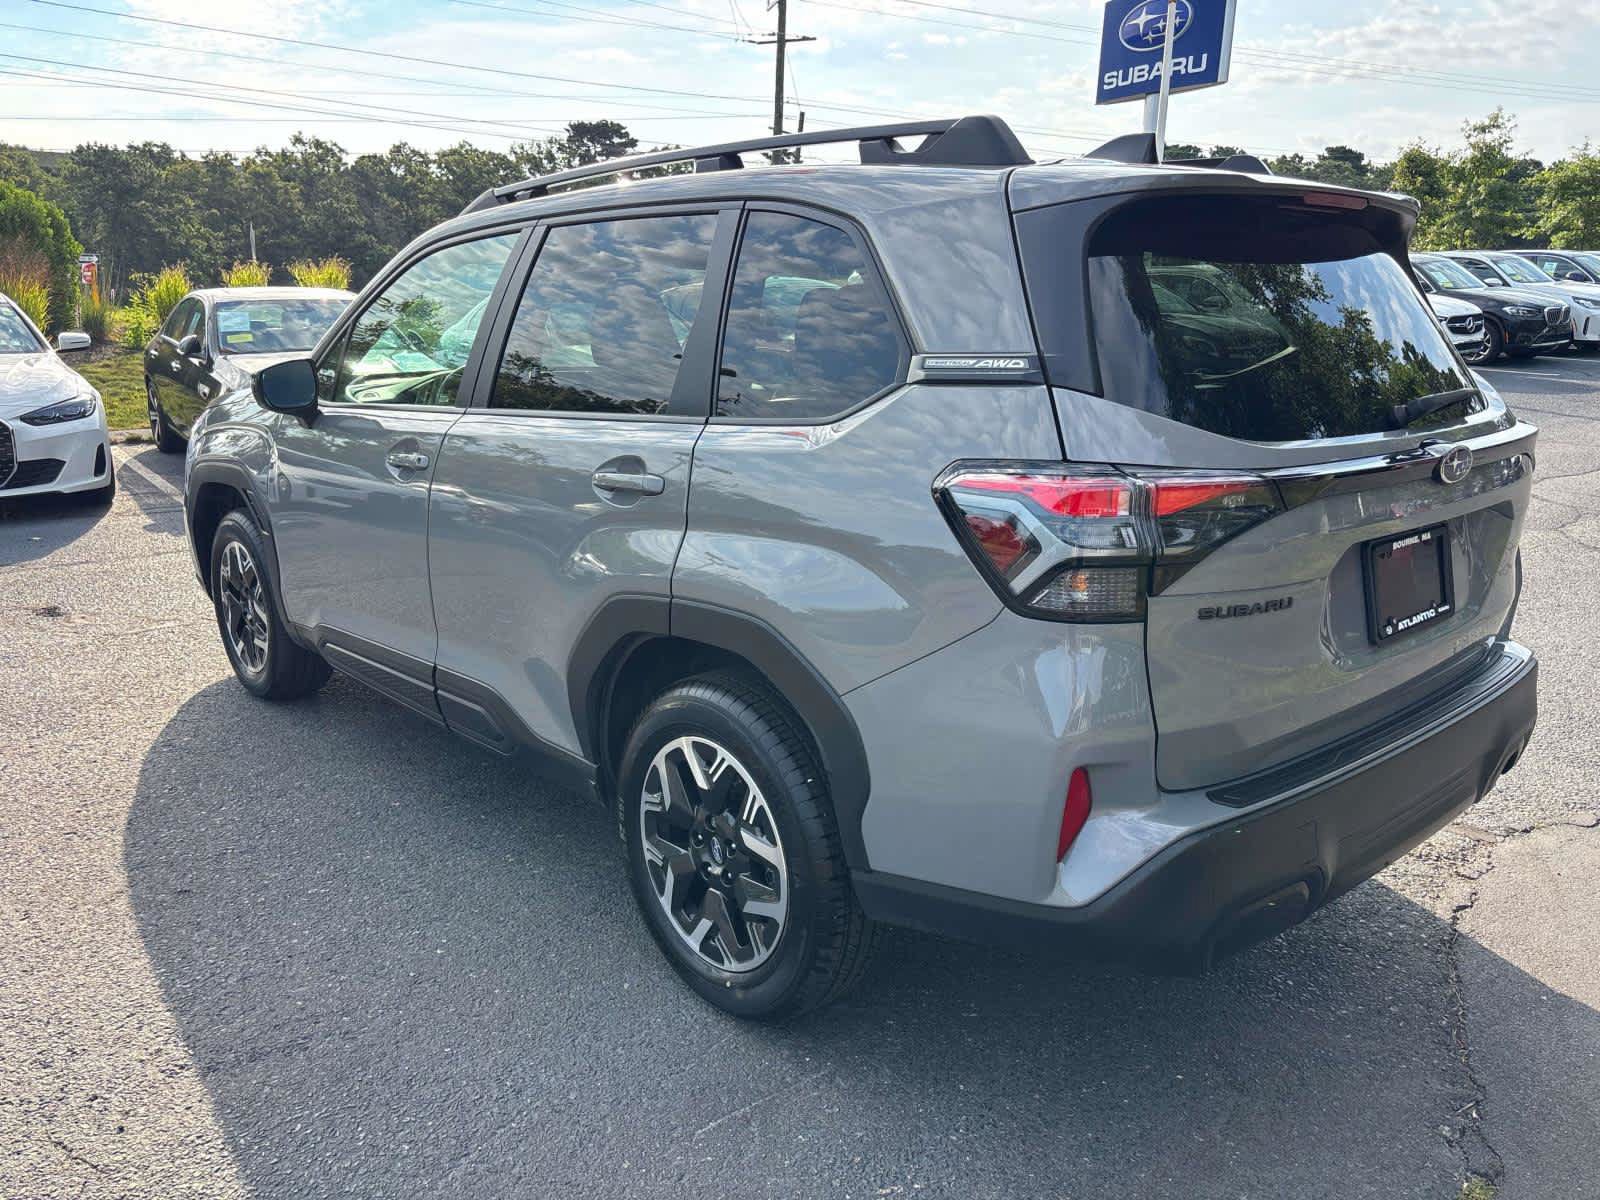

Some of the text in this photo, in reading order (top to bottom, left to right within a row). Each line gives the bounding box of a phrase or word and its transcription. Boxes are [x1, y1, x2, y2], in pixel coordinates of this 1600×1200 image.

[1103, 53, 1208, 90] SUBARU
[975, 359, 1025, 368] AWD
[1198, 596, 1293, 620] SUBARU
[1398, 609, 1436, 631] ATLANTIC
